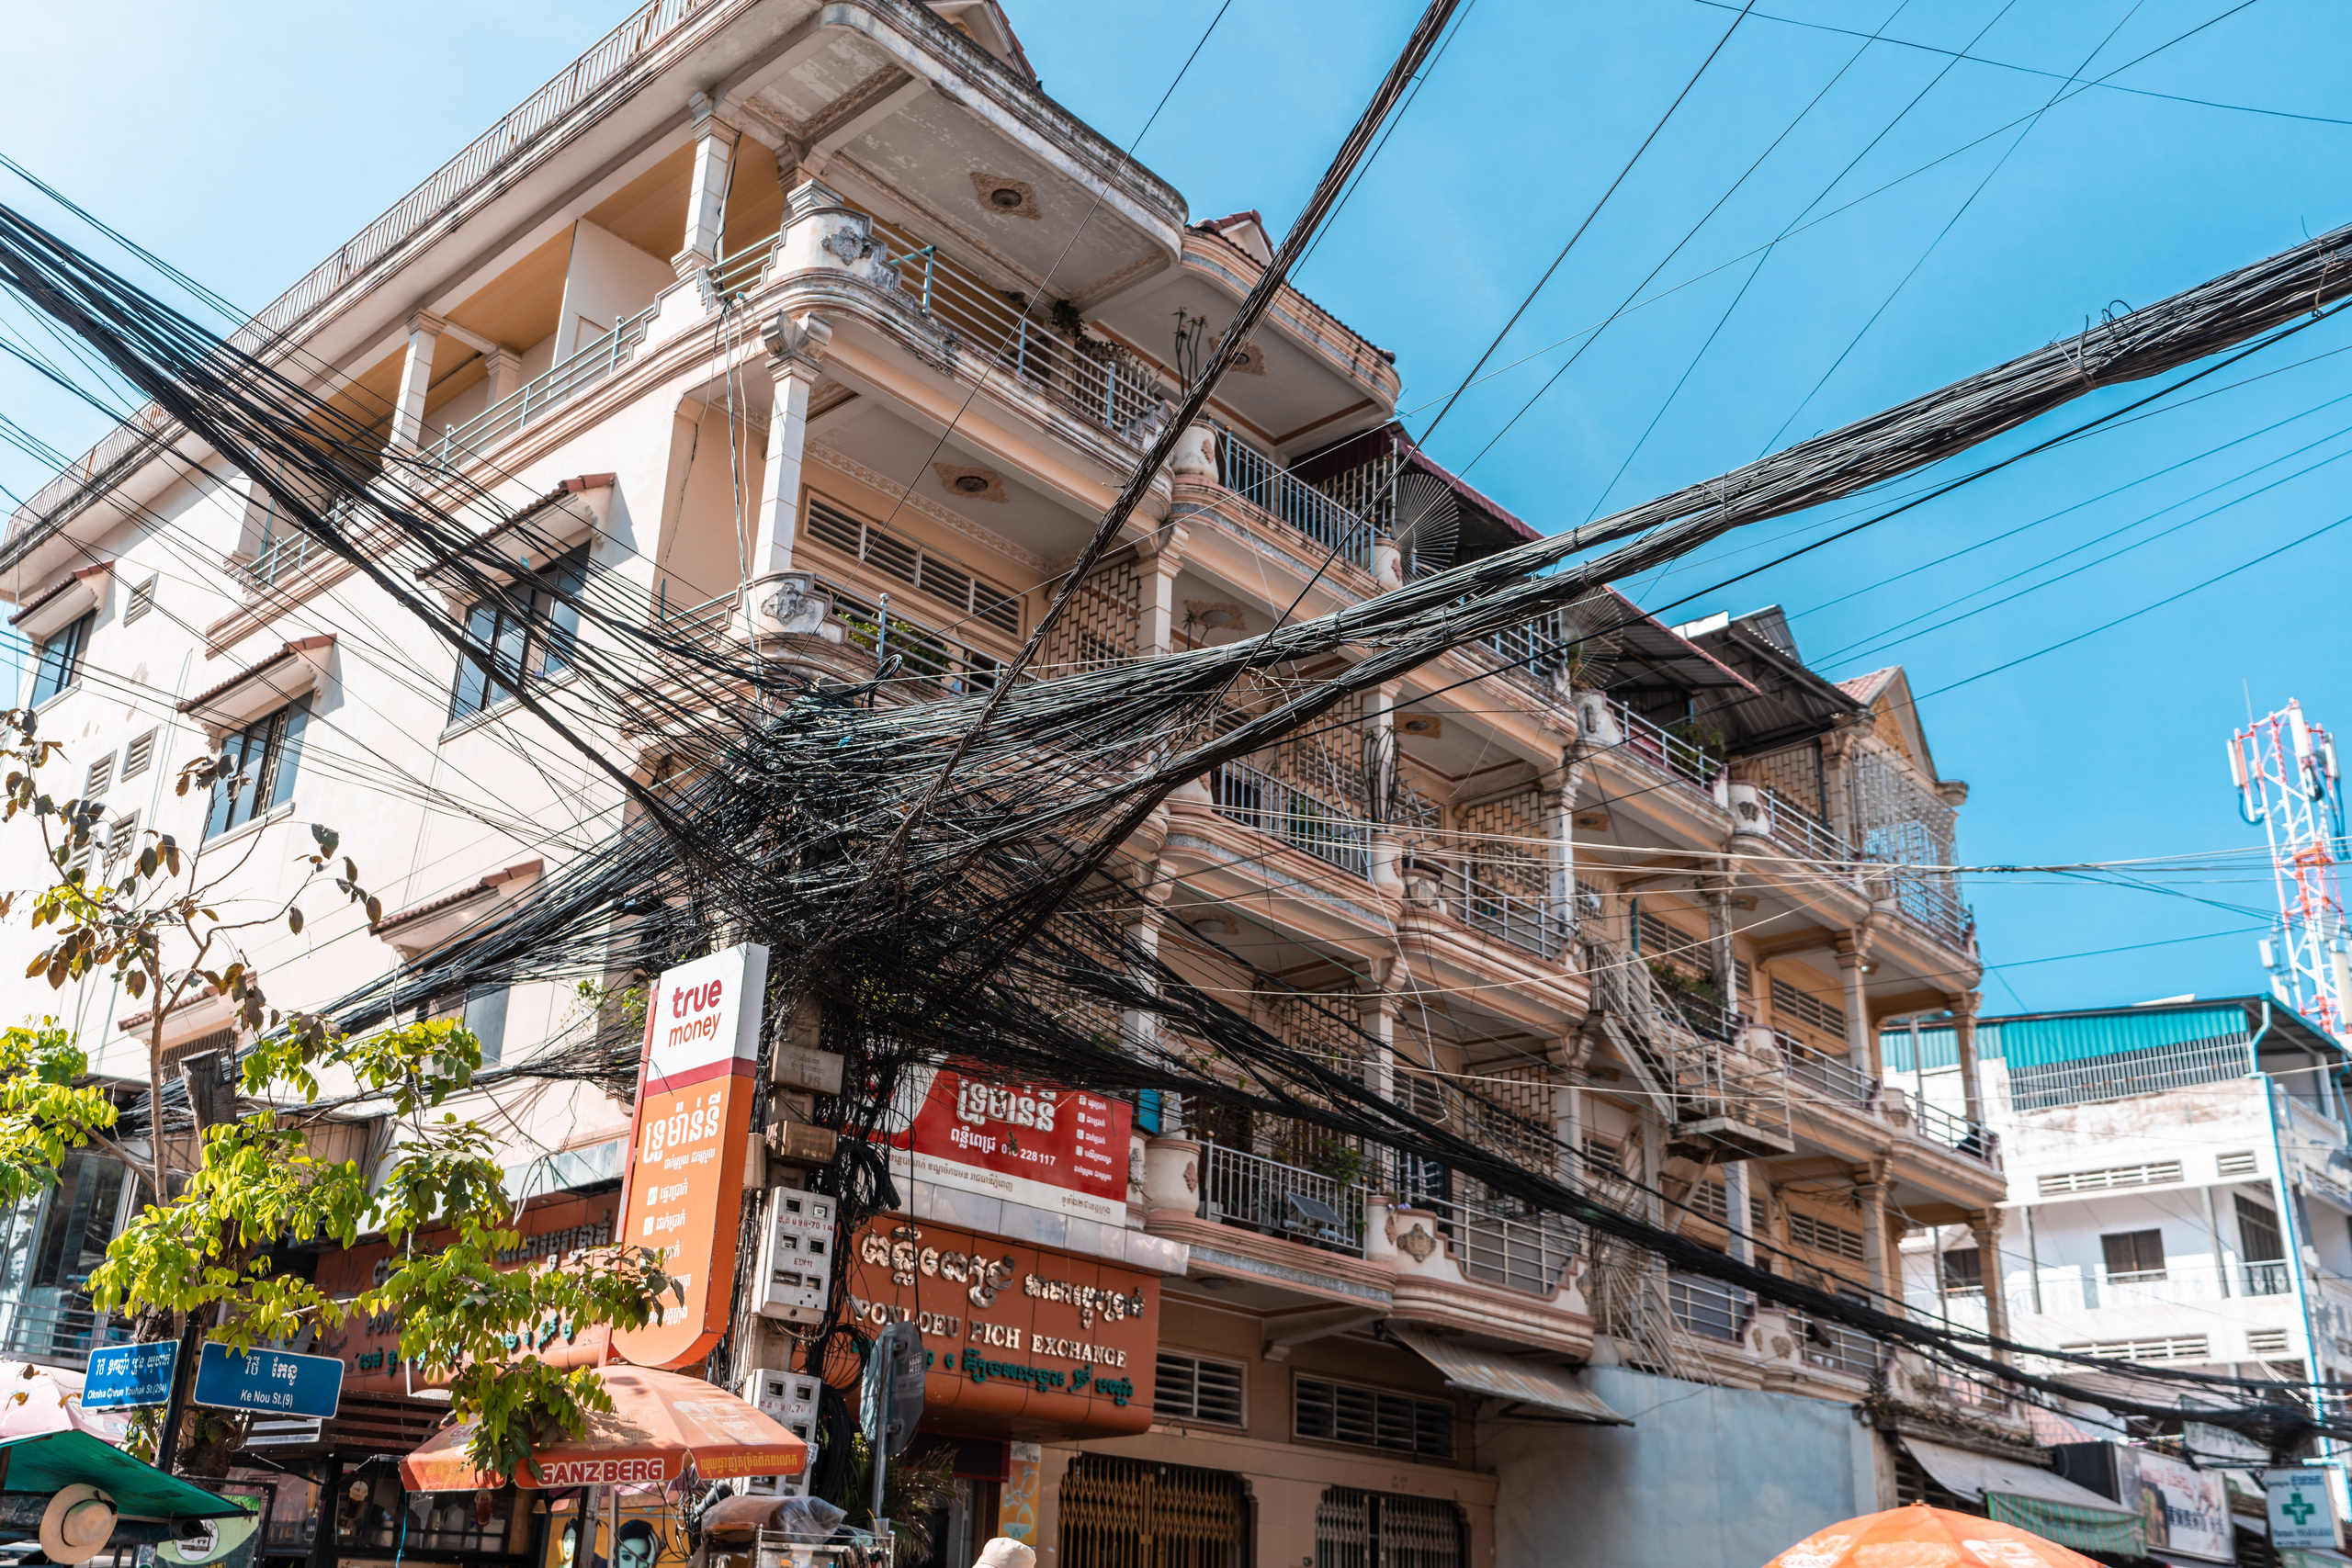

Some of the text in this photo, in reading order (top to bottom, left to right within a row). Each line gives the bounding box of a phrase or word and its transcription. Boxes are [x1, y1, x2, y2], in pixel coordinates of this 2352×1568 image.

[673, 979, 723, 1019] true
[668, 1012, 721, 1048] money
[643, 1090, 721, 1164] ទ្រូម៉ាន់នី
[1020, 1148, 1037, 1162] 228
[1039, 1153, 1057, 1167] 117
[969, 1320, 1022, 1350] PICH
[1032, 1334, 1127, 1368] EXCHANGE
[244, 1355, 261, 1376] វិថី
[87, 1383, 167, 1400] Oknha Chrun Youhak St.(294)
[240, 1389, 293, 1409] Ke Nou St.(9)
[540, 1459, 663, 1484] GANZBERG
